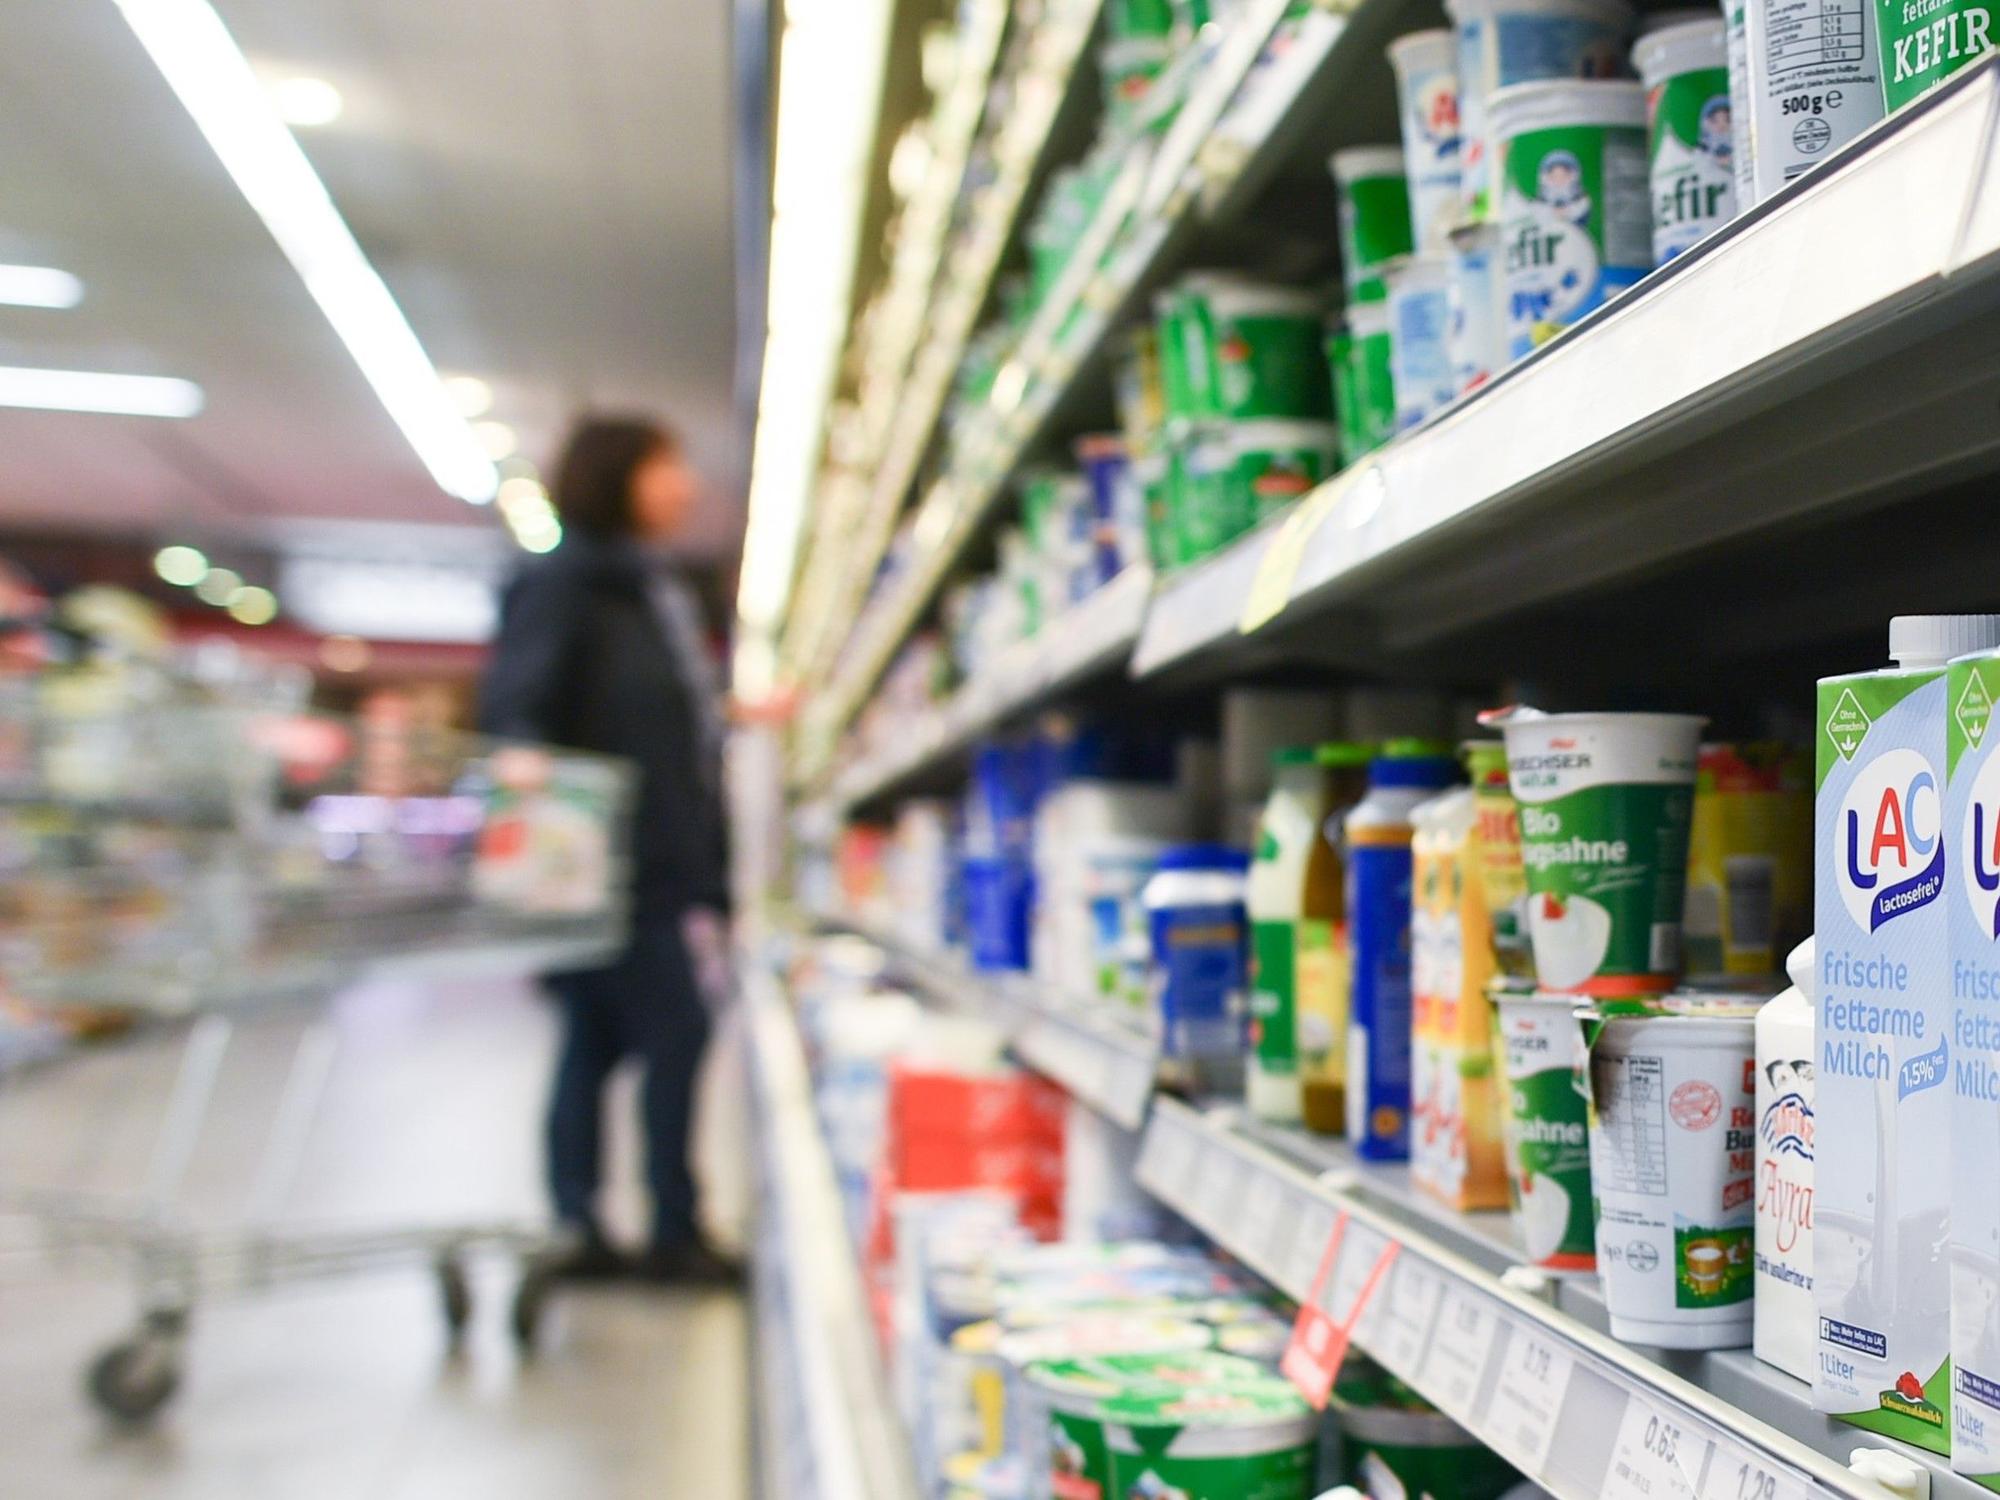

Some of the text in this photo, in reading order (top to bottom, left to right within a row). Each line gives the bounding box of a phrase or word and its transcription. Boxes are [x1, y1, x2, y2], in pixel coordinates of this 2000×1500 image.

[1893, 8, 1996, 84] KEFIR
[1522, 807, 1561, 835] Bio
[1847, 771, 1935, 890] LAC
[1879, 876, 1936, 914] lactosefrei
[1824, 950, 1908, 992] frische
[1824, 994, 1926, 1040] fettarme
[1823, 1039, 1891, 1081] Milch
[1901, 1057, 1935, 1089] 1,5%
[1955, 1058, 2000, 1102] Milc
